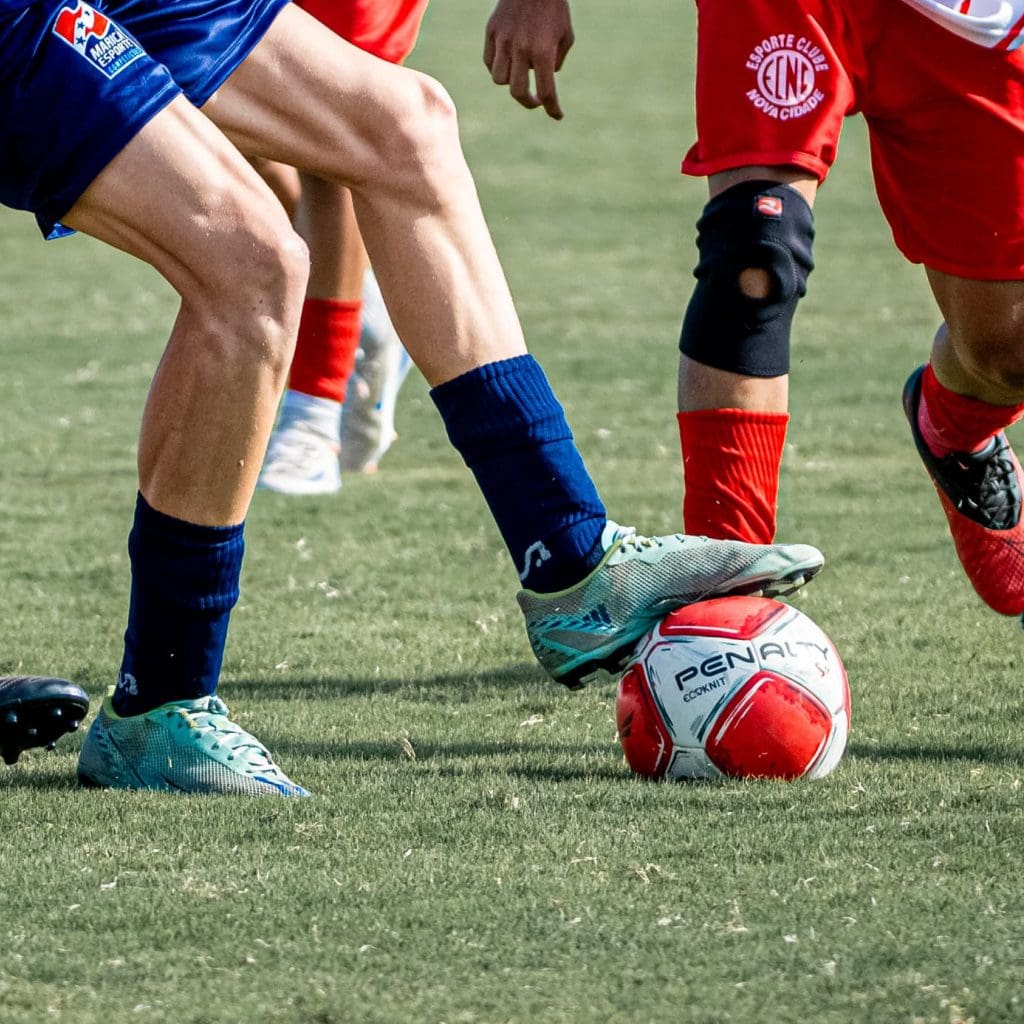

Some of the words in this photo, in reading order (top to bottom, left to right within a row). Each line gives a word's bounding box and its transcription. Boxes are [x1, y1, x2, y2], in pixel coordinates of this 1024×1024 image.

[97, 38, 134, 67] ESPORTE
[745, 34, 795, 71] ESPORTE
[795, 36, 829, 72] CLUBE
[745, 88, 779, 119] NOVA
[779, 88, 825, 121] CIDADE
[674, 641, 829, 692] PENALTY
[682, 676, 727, 704] ECOKNIT
